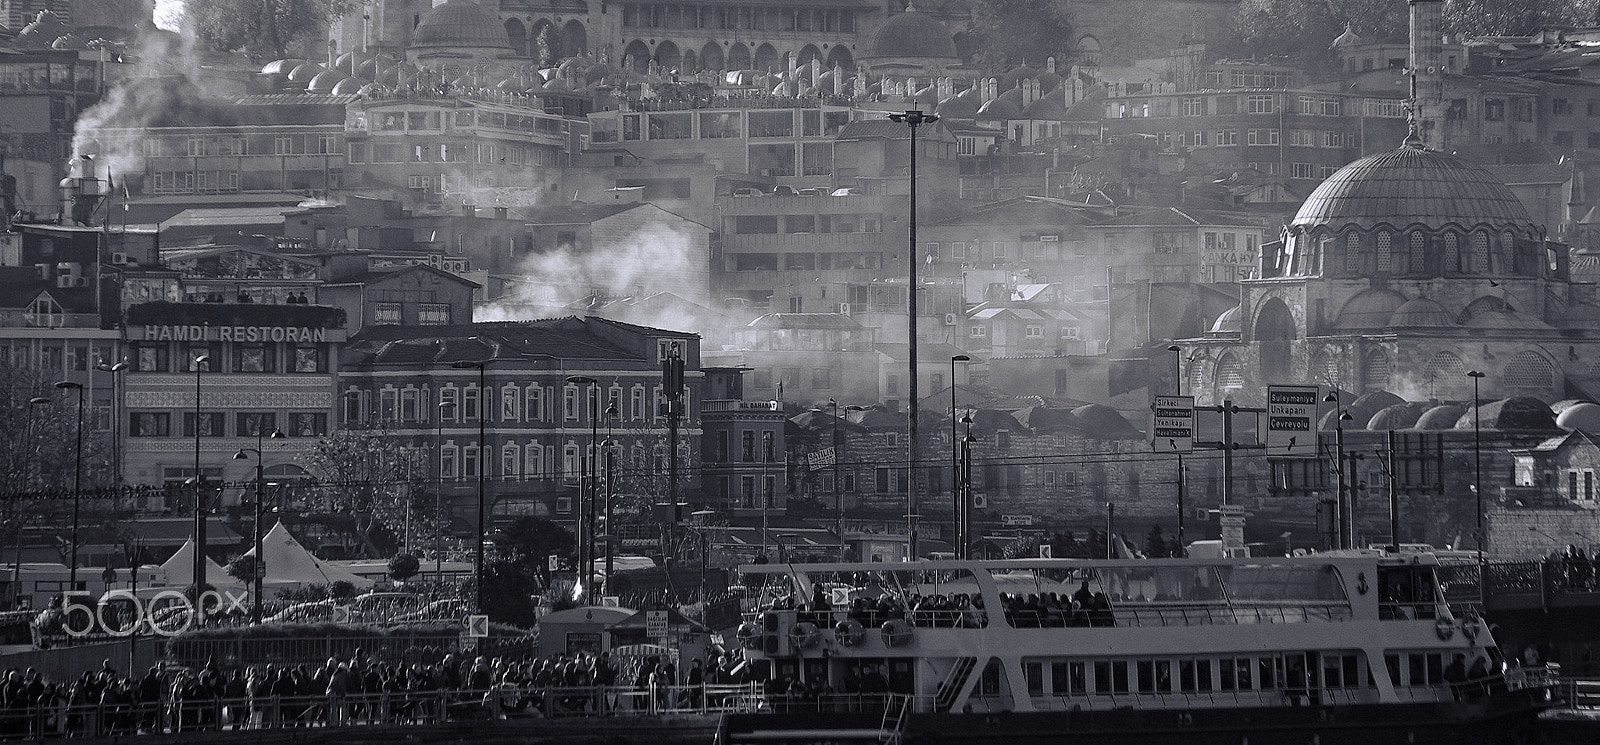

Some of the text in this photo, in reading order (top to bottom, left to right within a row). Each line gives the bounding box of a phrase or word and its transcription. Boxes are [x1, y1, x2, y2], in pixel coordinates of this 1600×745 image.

[145, 321, 325, 342] HAMDİ RESTORAN
[1157, 399, 1179, 407] Sirkeci
[1270, 418, 1308, 430] Çevreyolu
